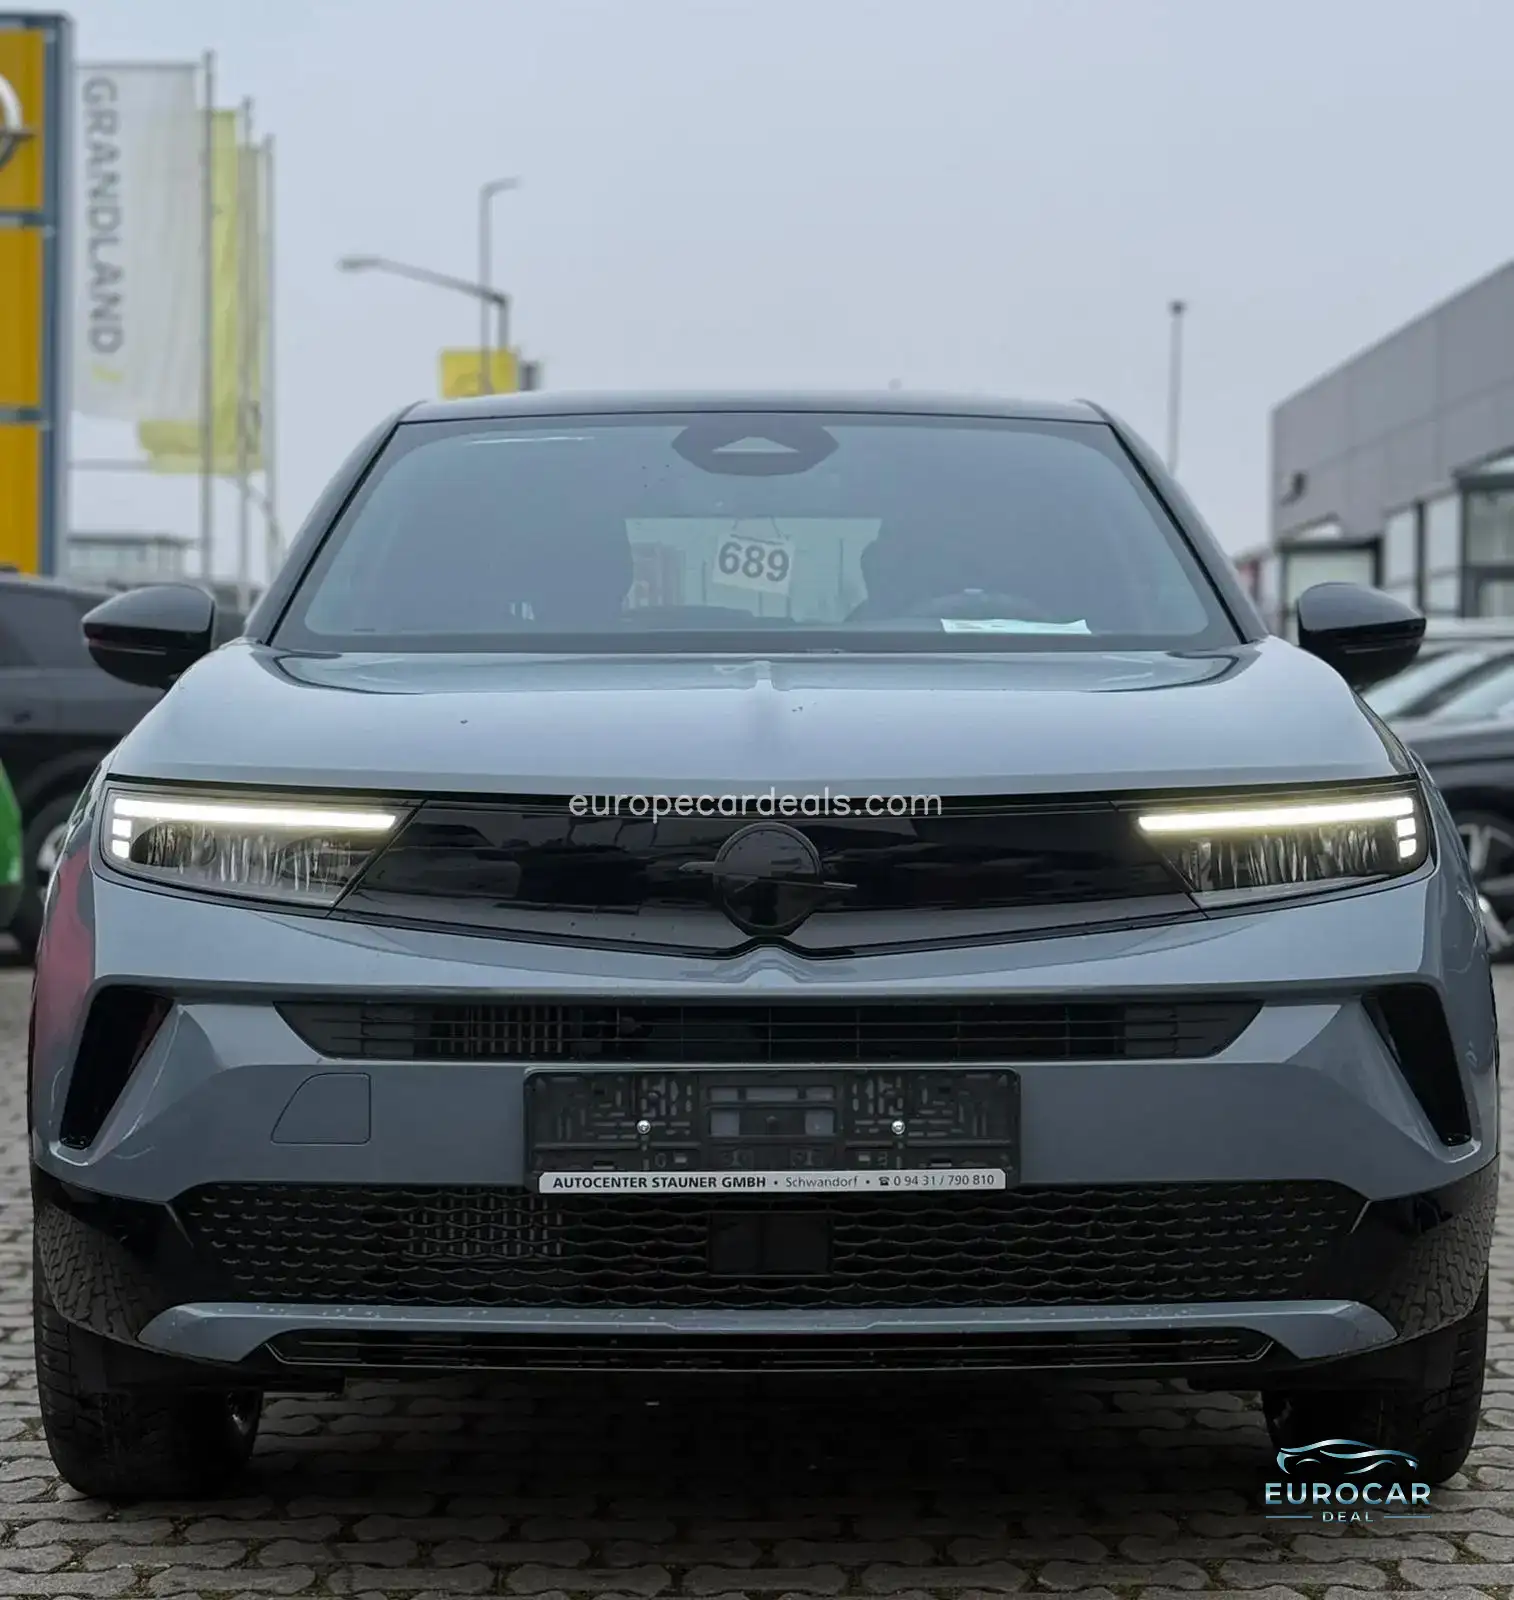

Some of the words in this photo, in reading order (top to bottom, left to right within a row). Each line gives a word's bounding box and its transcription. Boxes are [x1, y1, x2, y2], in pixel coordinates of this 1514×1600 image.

[82, 76, 125, 354] GRANDLAND
[718, 541, 790, 583] 689
[552, 1176, 648, 1189] AUTOCENTER
[651, 1176, 717, 1189] STAUNER
[721, 1176, 767, 1188] GMBH
[785, 1175, 859, 1188] Schwandorf
[972, 1174, 995, 1186] 810
